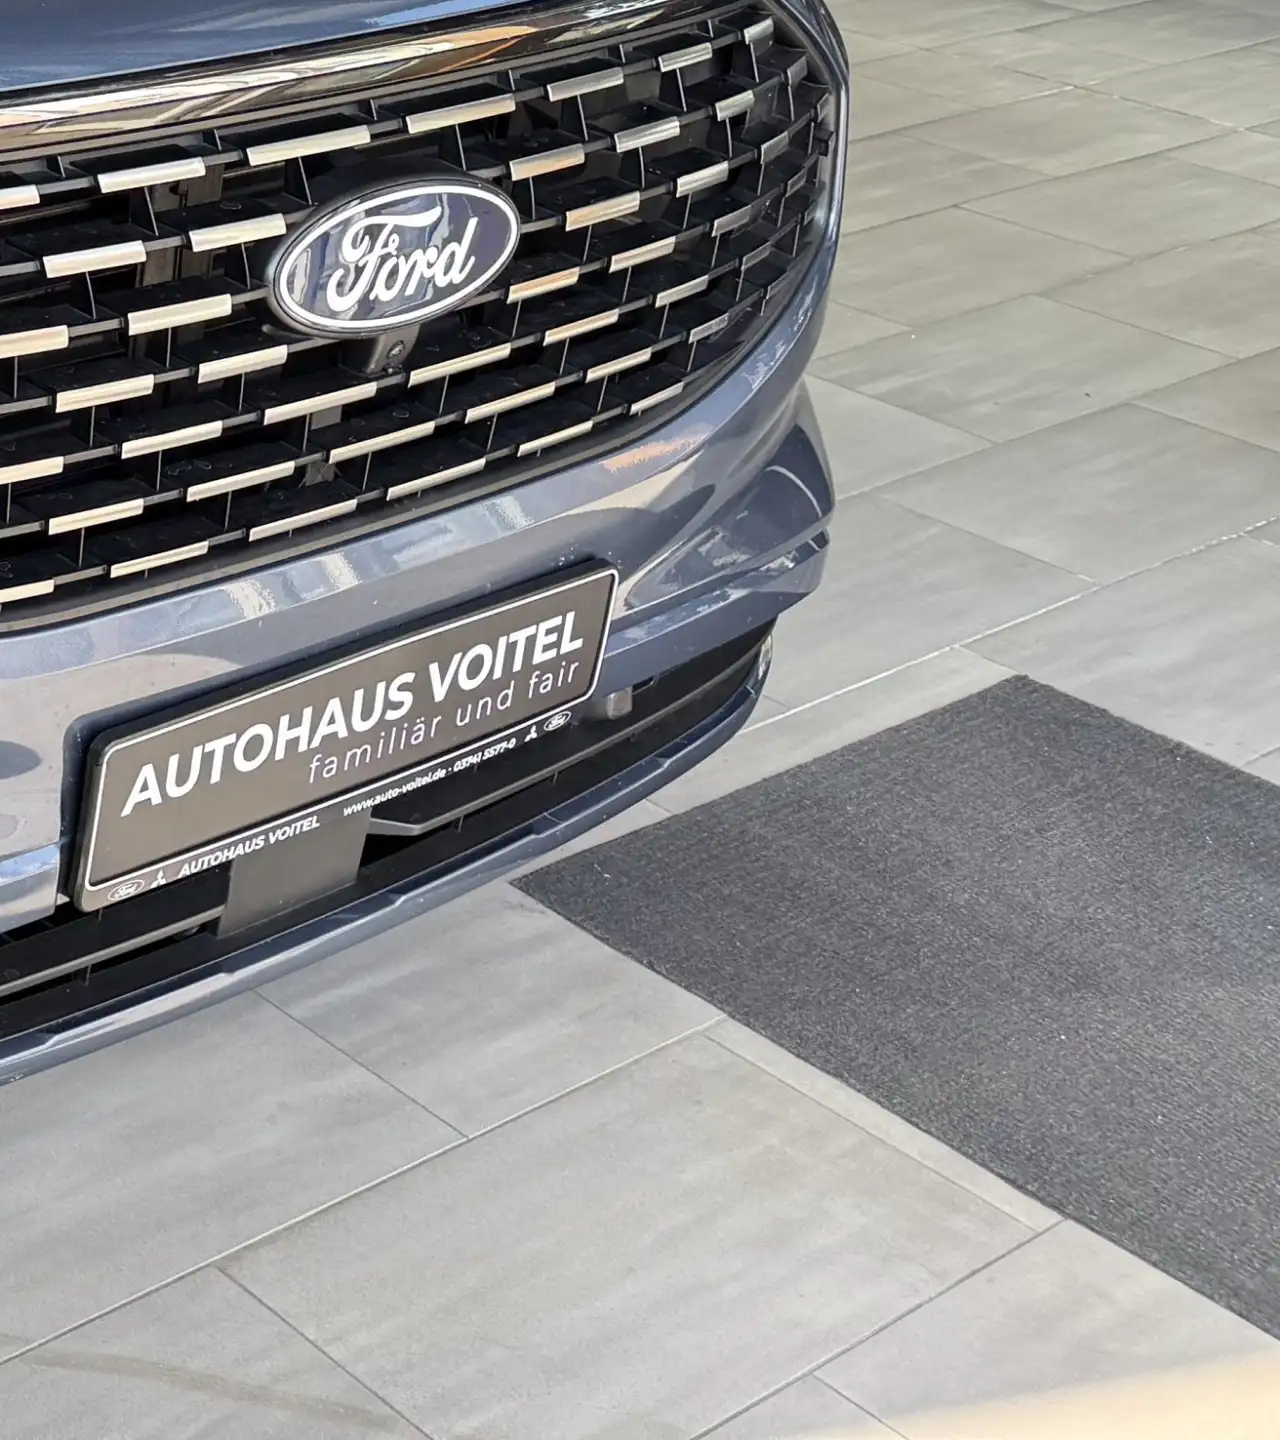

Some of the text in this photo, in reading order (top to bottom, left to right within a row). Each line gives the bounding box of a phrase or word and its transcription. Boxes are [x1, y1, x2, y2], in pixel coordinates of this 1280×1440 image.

[326, 206, 479, 312] Ford
[120, 611, 583, 817] AUTOHAUS VOITEL
[308, 661, 579, 784] familiär und fair
[343, 767, 447, 817] www.auto-voitel.de
[177, 815, 320, 879] AUTOHAUS VOITEL
